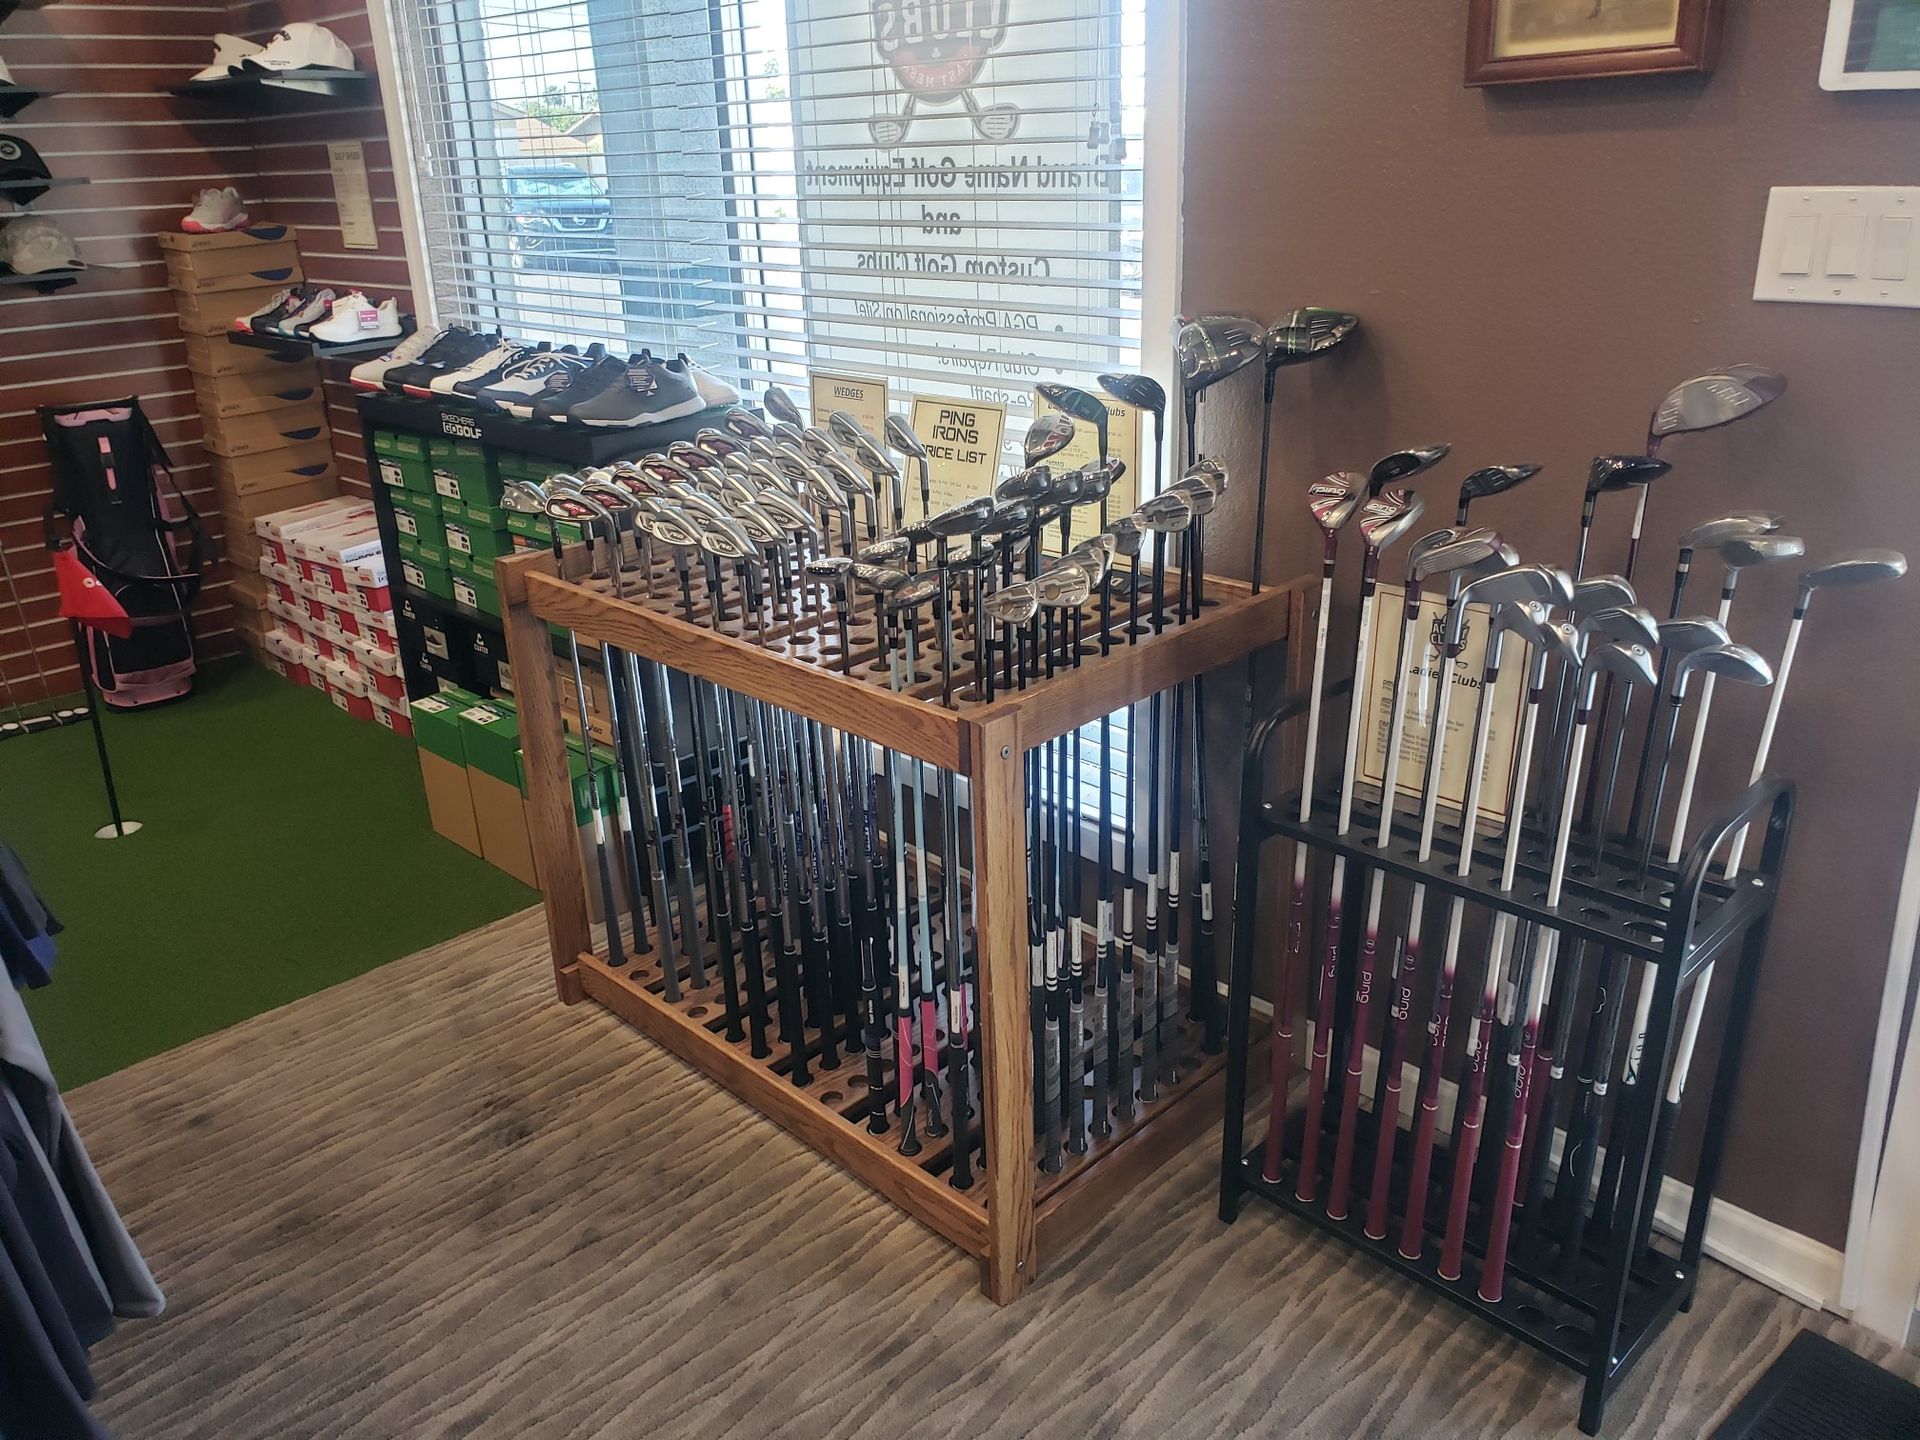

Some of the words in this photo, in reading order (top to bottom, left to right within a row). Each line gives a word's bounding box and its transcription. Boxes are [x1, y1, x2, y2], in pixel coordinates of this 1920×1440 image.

[834, 386, 864, 399] WEDGES
[939, 410, 976, 428] PING
[1107, 405, 1126, 417] lubs
[932, 427, 979, 444] IRONS
[921, 444, 954, 460] RICE
[957, 448, 987, 465] LIST
[1431, 633, 1467, 650] CLS
[1409, 666, 1439, 679] adie
[1356, 970, 1372, 1004] ping
